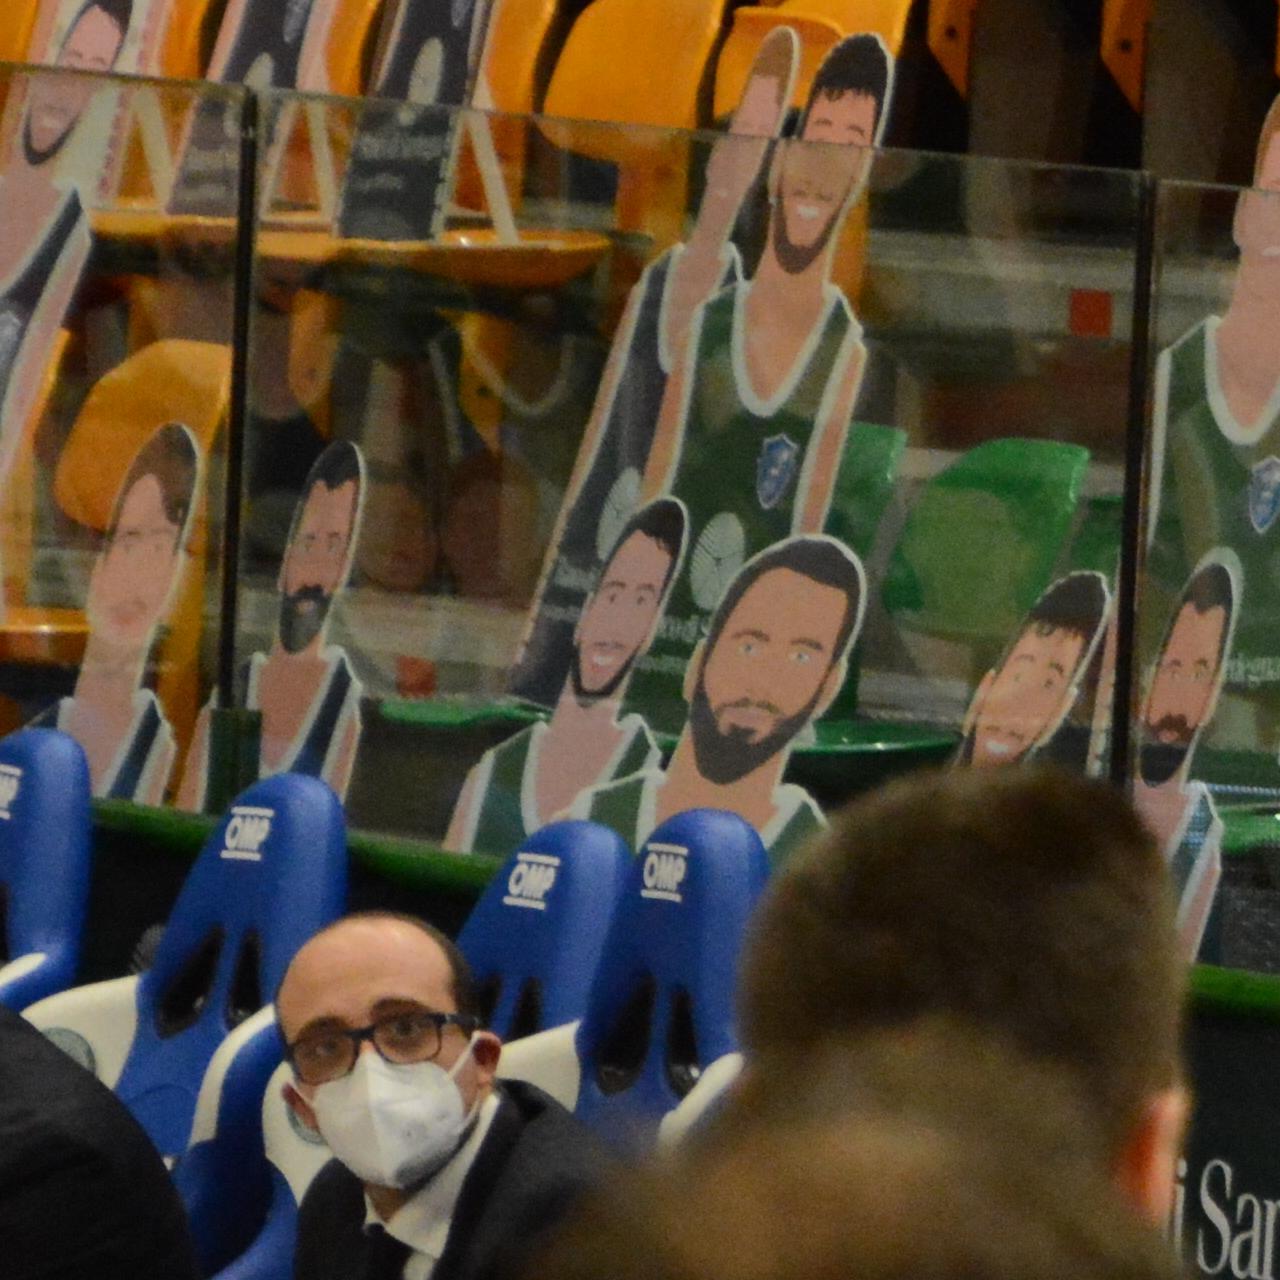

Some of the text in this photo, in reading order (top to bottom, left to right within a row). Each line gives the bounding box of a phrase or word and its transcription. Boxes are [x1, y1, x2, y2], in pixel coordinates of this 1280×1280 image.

[223, 813, 272, 853] OMP
[507, 860, 558, 901] OMP
[642, 851, 688, 893] OMP
